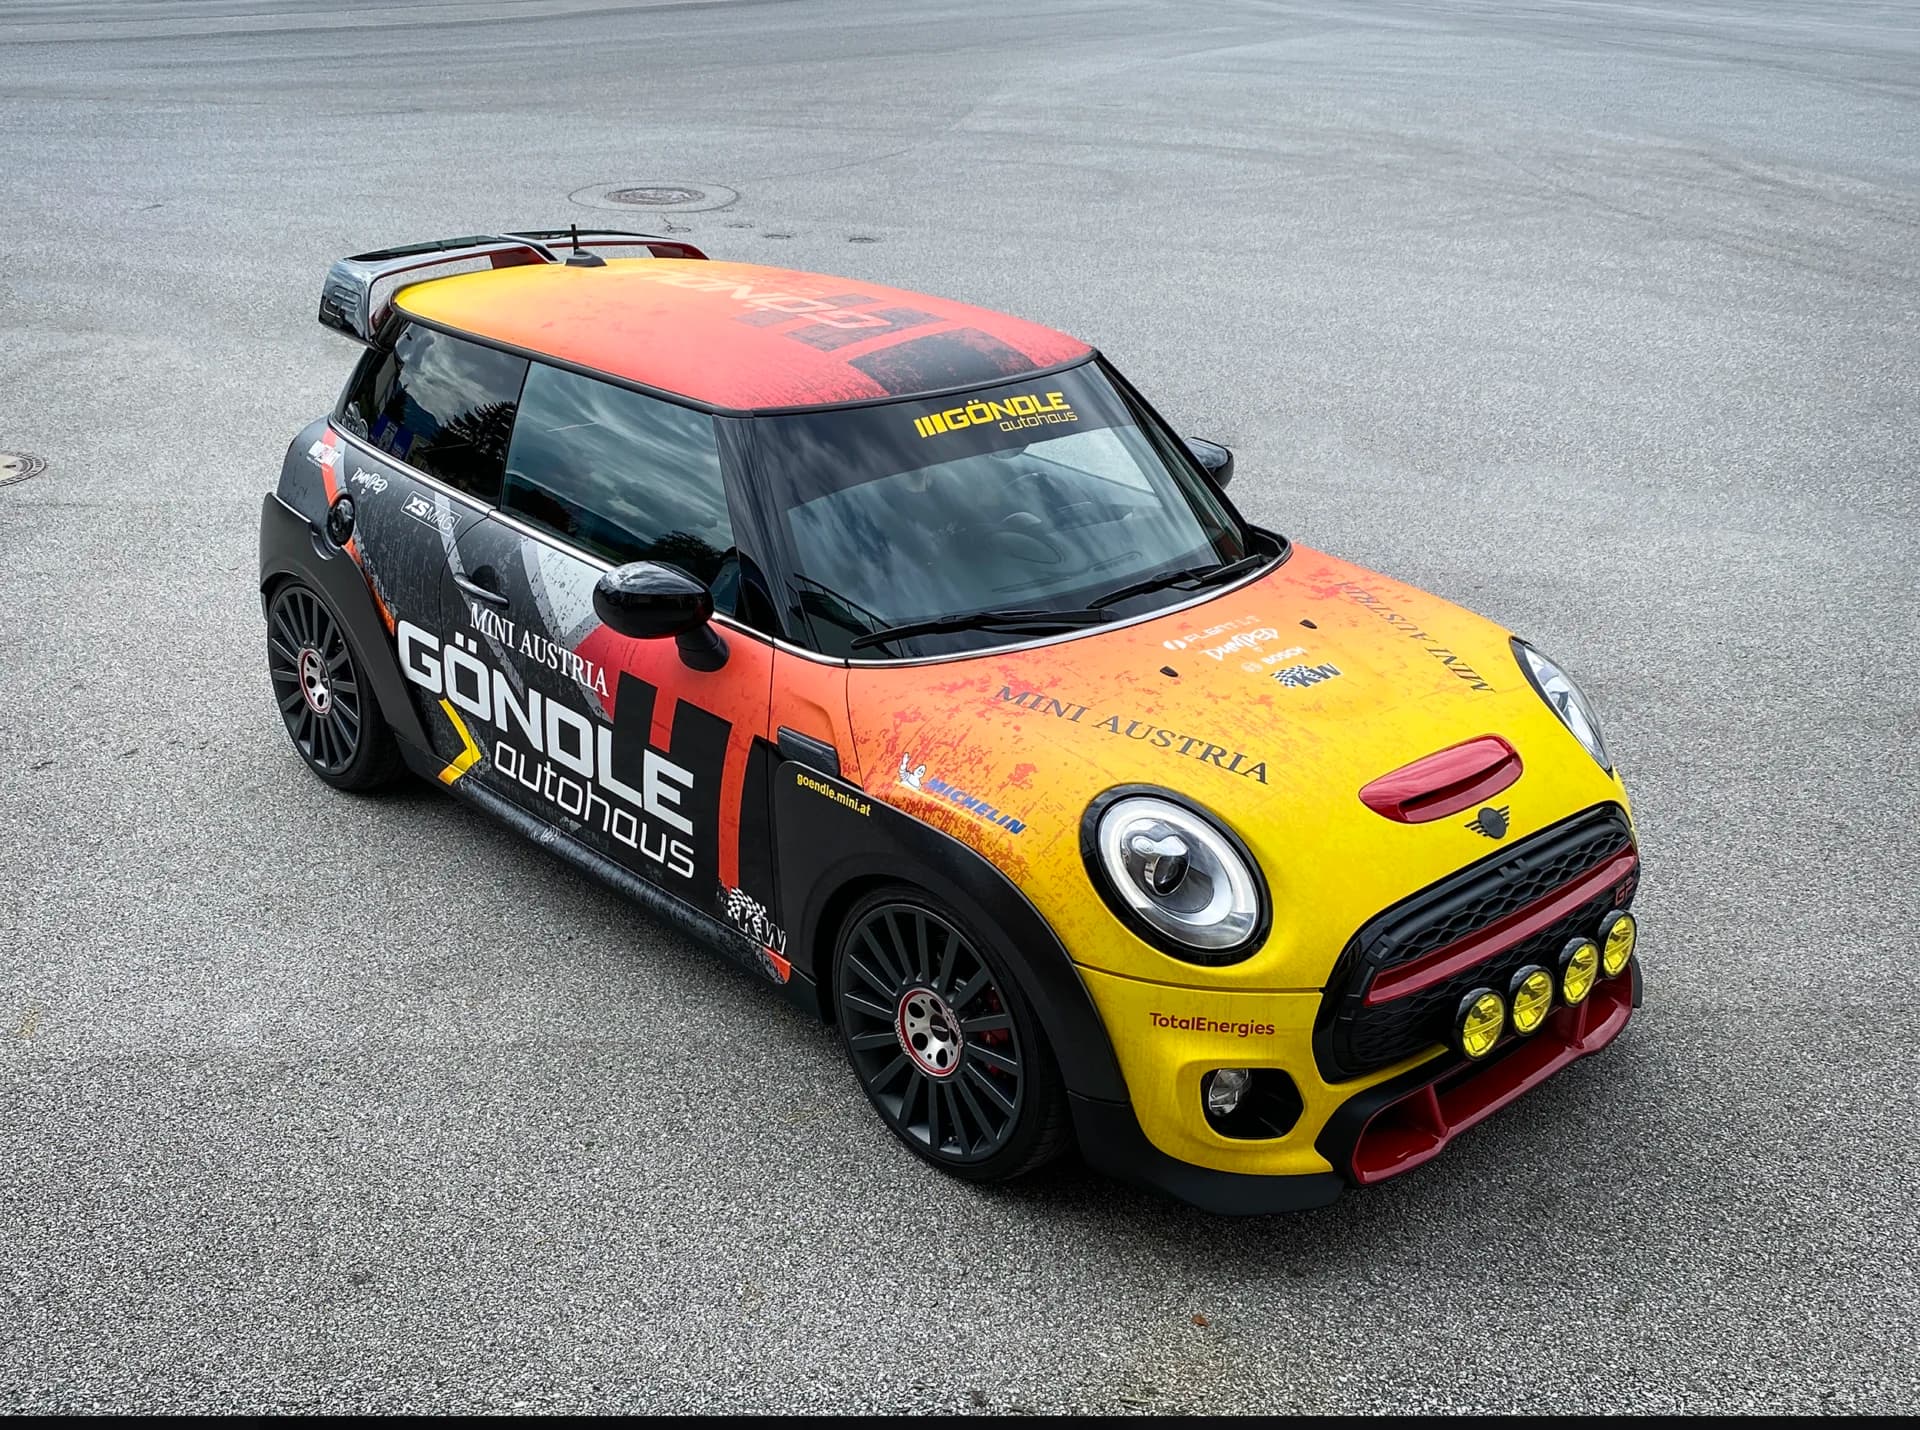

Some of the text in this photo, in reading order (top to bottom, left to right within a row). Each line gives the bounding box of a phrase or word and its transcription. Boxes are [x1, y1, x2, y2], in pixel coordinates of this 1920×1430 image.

[941, 392, 1071, 430] GÖNDLE
[999, 411, 1078, 432] autohaus
[469, 602, 610, 697] MINI AUSTRIA
[1425, 647, 1497, 693] MINI
[397, 619, 694, 836] GÖNDLE
[994, 684, 1270, 785] MINI AUSTRIA
[494, 740, 695, 879] autohaus
[796, 773, 871, 817] goendle.mini.at
[923, 777, 1027, 835] MICHELIN
[736, 902, 787, 955] KW
[1149, 1012, 1275, 1038] TotalEnergies
